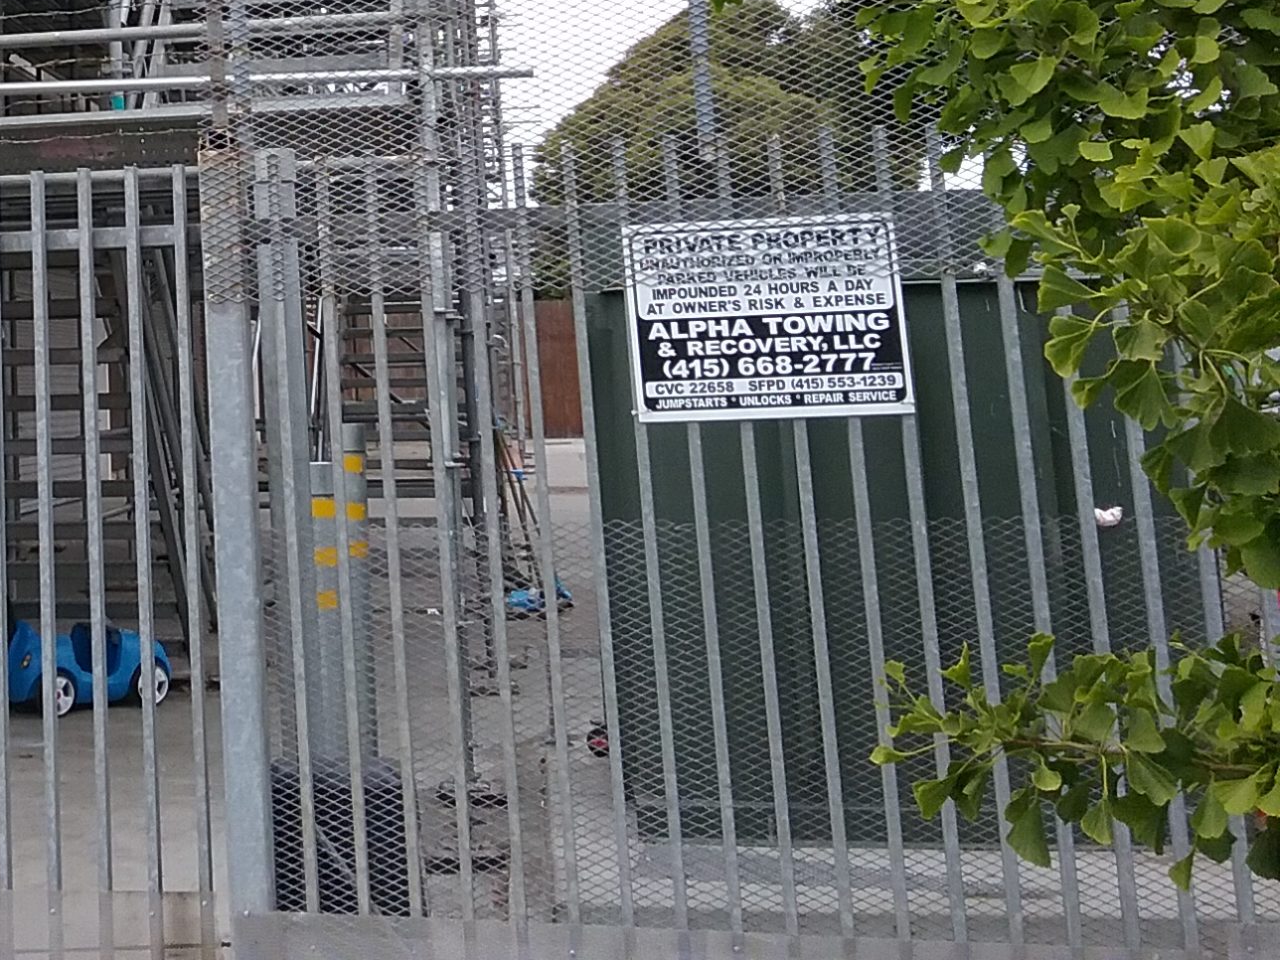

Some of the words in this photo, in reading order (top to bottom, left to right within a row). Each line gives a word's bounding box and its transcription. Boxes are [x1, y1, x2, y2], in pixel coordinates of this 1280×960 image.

[643, 235, 742, 253] PRIVATE
[751, 227, 880, 247] PROPERTY
[652, 285, 737, 300] IMPOUNDED
[743, 284, 762, 296] 24
[768, 282, 819, 295] HOURS
[827, 281, 838, 292] A
[845, 279, 874, 291] DAY
[647, 303, 665, 315] AT
[672, 299, 742, 314] OWNER'S
[748, 298, 785, 311] RISK
[794, 297, 805, 308] &
[813, 293, 886, 308] EXPENSE
[648, 319, 754, 340] ALPHA
[762, 313, 890, 335] TOWING
[657, 342, 677, 357] &
[687, 337, 828, 356] RECOVERY,
[833, 333, 882, 350] LLC
[663, 358, 729, 379] (415)
[738, 352, 876, 375] 668-2777
[655, 382, 684, 395] CVC
[689, 381, 734, 394] 22658
[748, 379, 786, 391] SFPD
[791, 377, 824, 390] (415)
[828, 375, 896, 388] 553-1239
[655, 396, 728, 409] JUMPSTARTS
[739, 394, 792, 406] UNLOCKS
[804, 392, 844, 404] REPAIR
[848, 390, 897, 402] SERVICE
